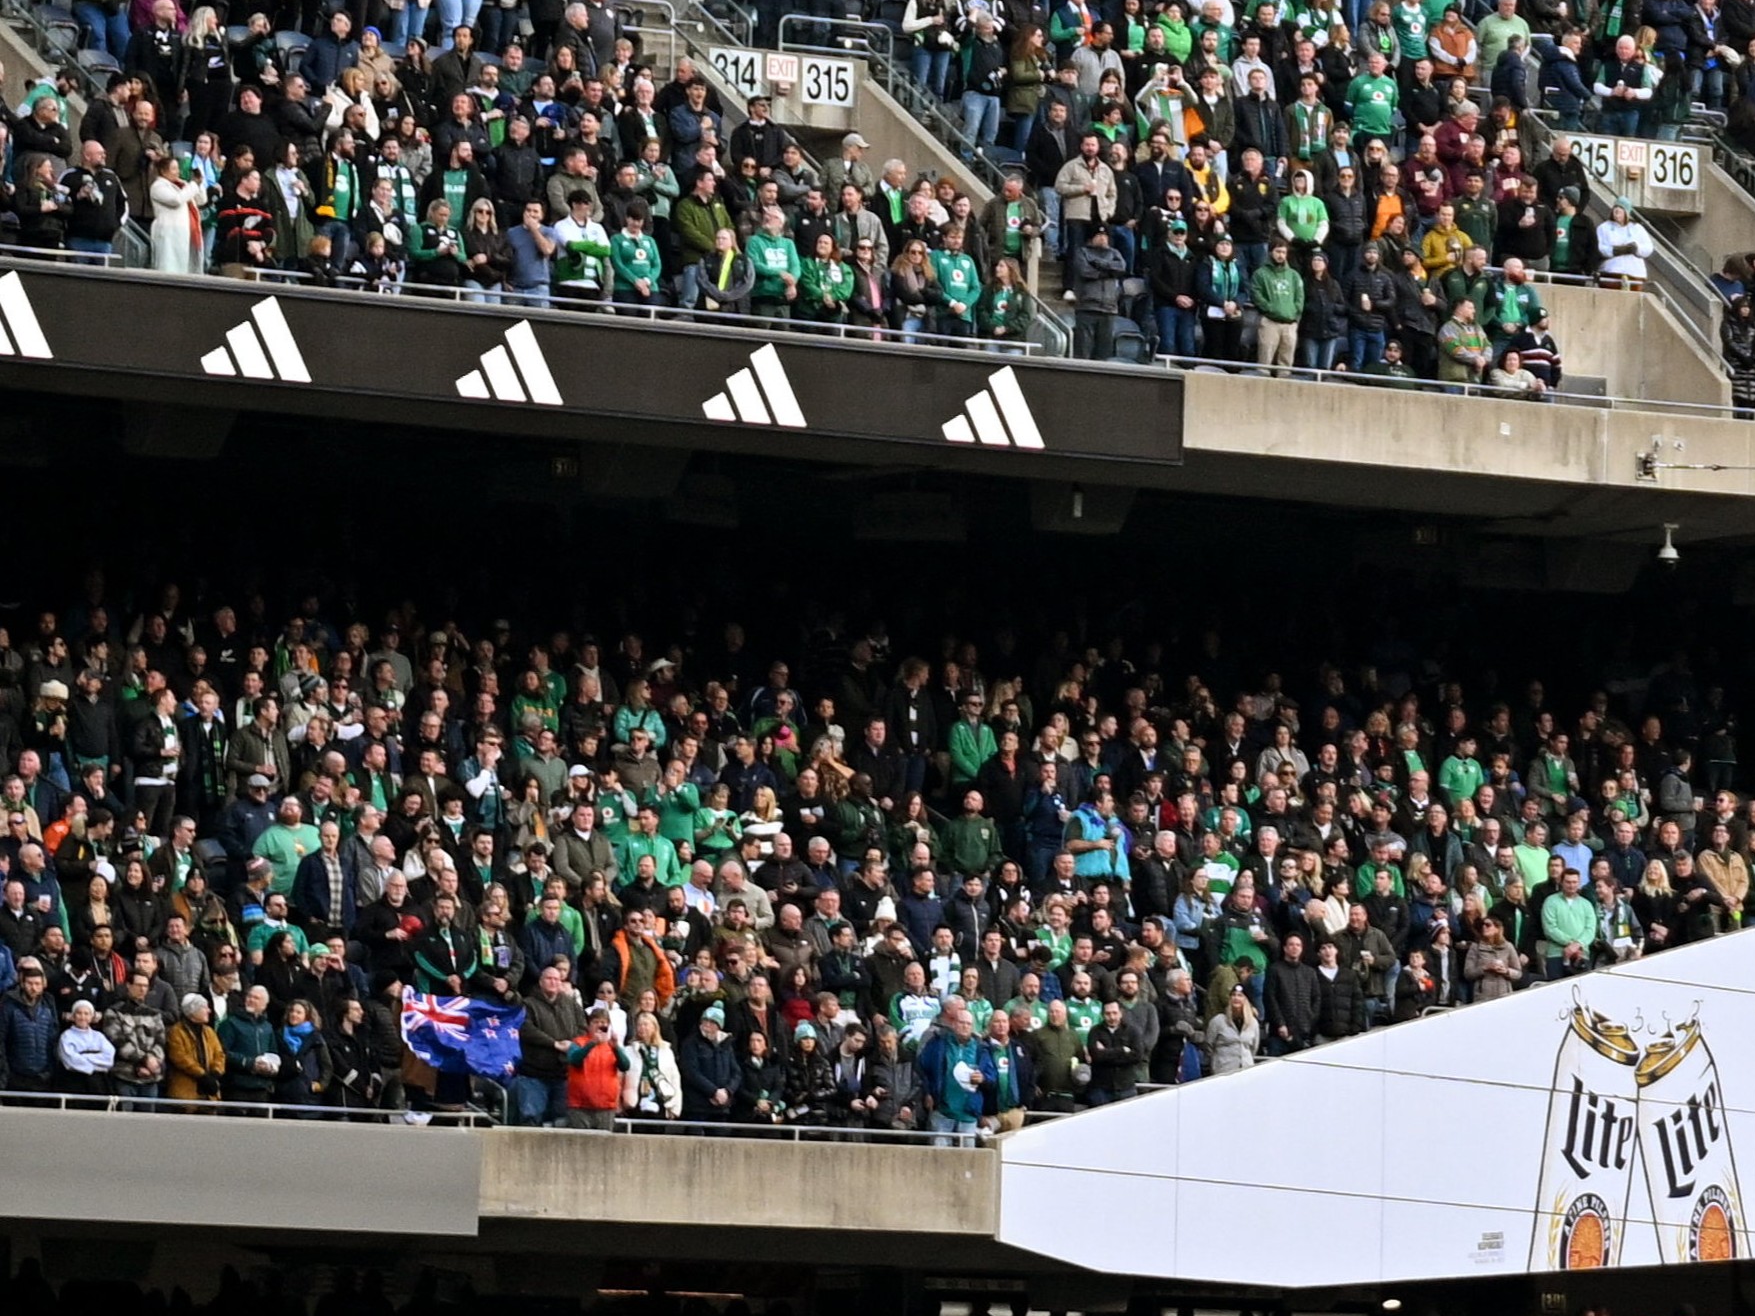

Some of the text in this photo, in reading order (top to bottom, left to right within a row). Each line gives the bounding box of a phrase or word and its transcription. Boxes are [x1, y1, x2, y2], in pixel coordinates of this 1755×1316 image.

[714, 52, 758, 91] 314
[767, 57, 798, 80] EXIT
[806, 62, 850, 101] 315
[1617, 143, 1646, 163] EXIT
[1654, 147, 1695, 185] 316
[1561, 1073, 1633, 1179] Lite
[1654, 1081, 1720, 1198] Lite
